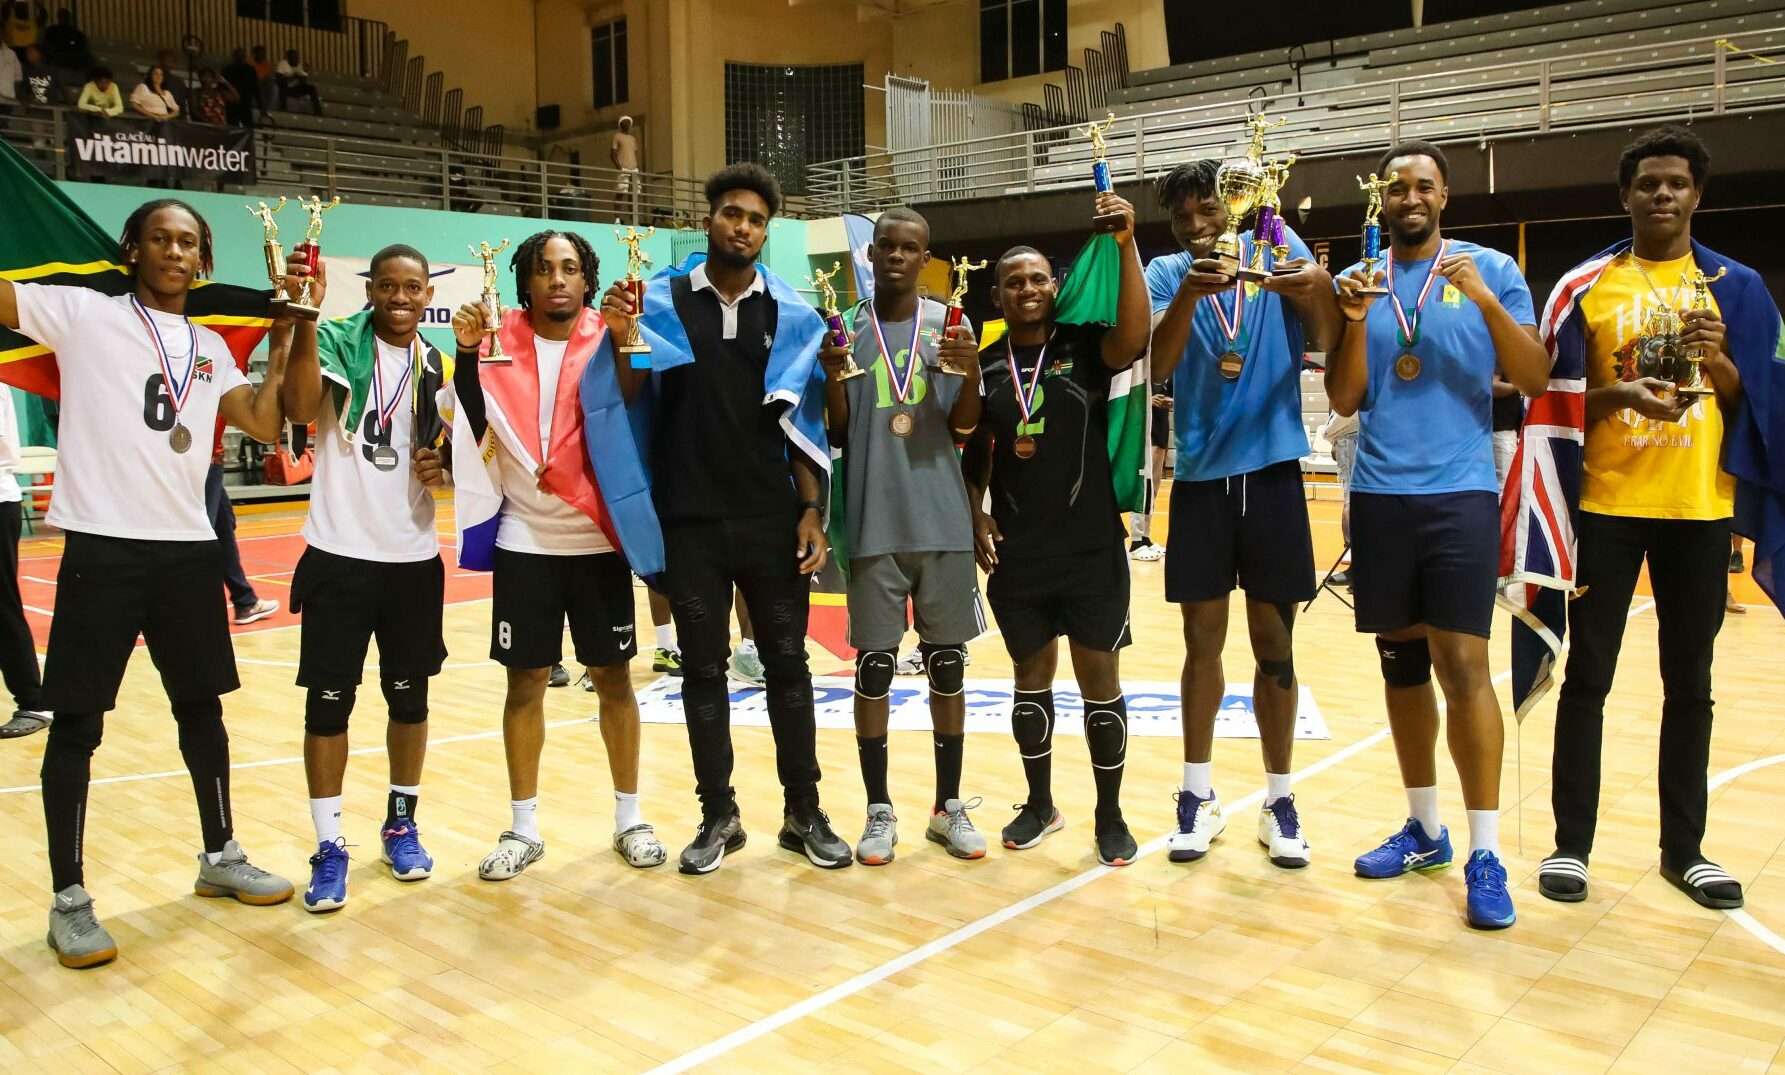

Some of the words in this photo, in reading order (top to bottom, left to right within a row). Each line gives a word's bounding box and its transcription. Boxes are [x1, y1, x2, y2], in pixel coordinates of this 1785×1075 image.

[75, 133, 249, 172] vitaminwater
[144, 373, 177, 431] 6
[192, 370, 213, 383] SKN
[869, 348, 927, 408] 13
[1016, 383, 1045, 436] 2
[362, 410, 393, 463] 9
[499, 620, 512, 650] 8
